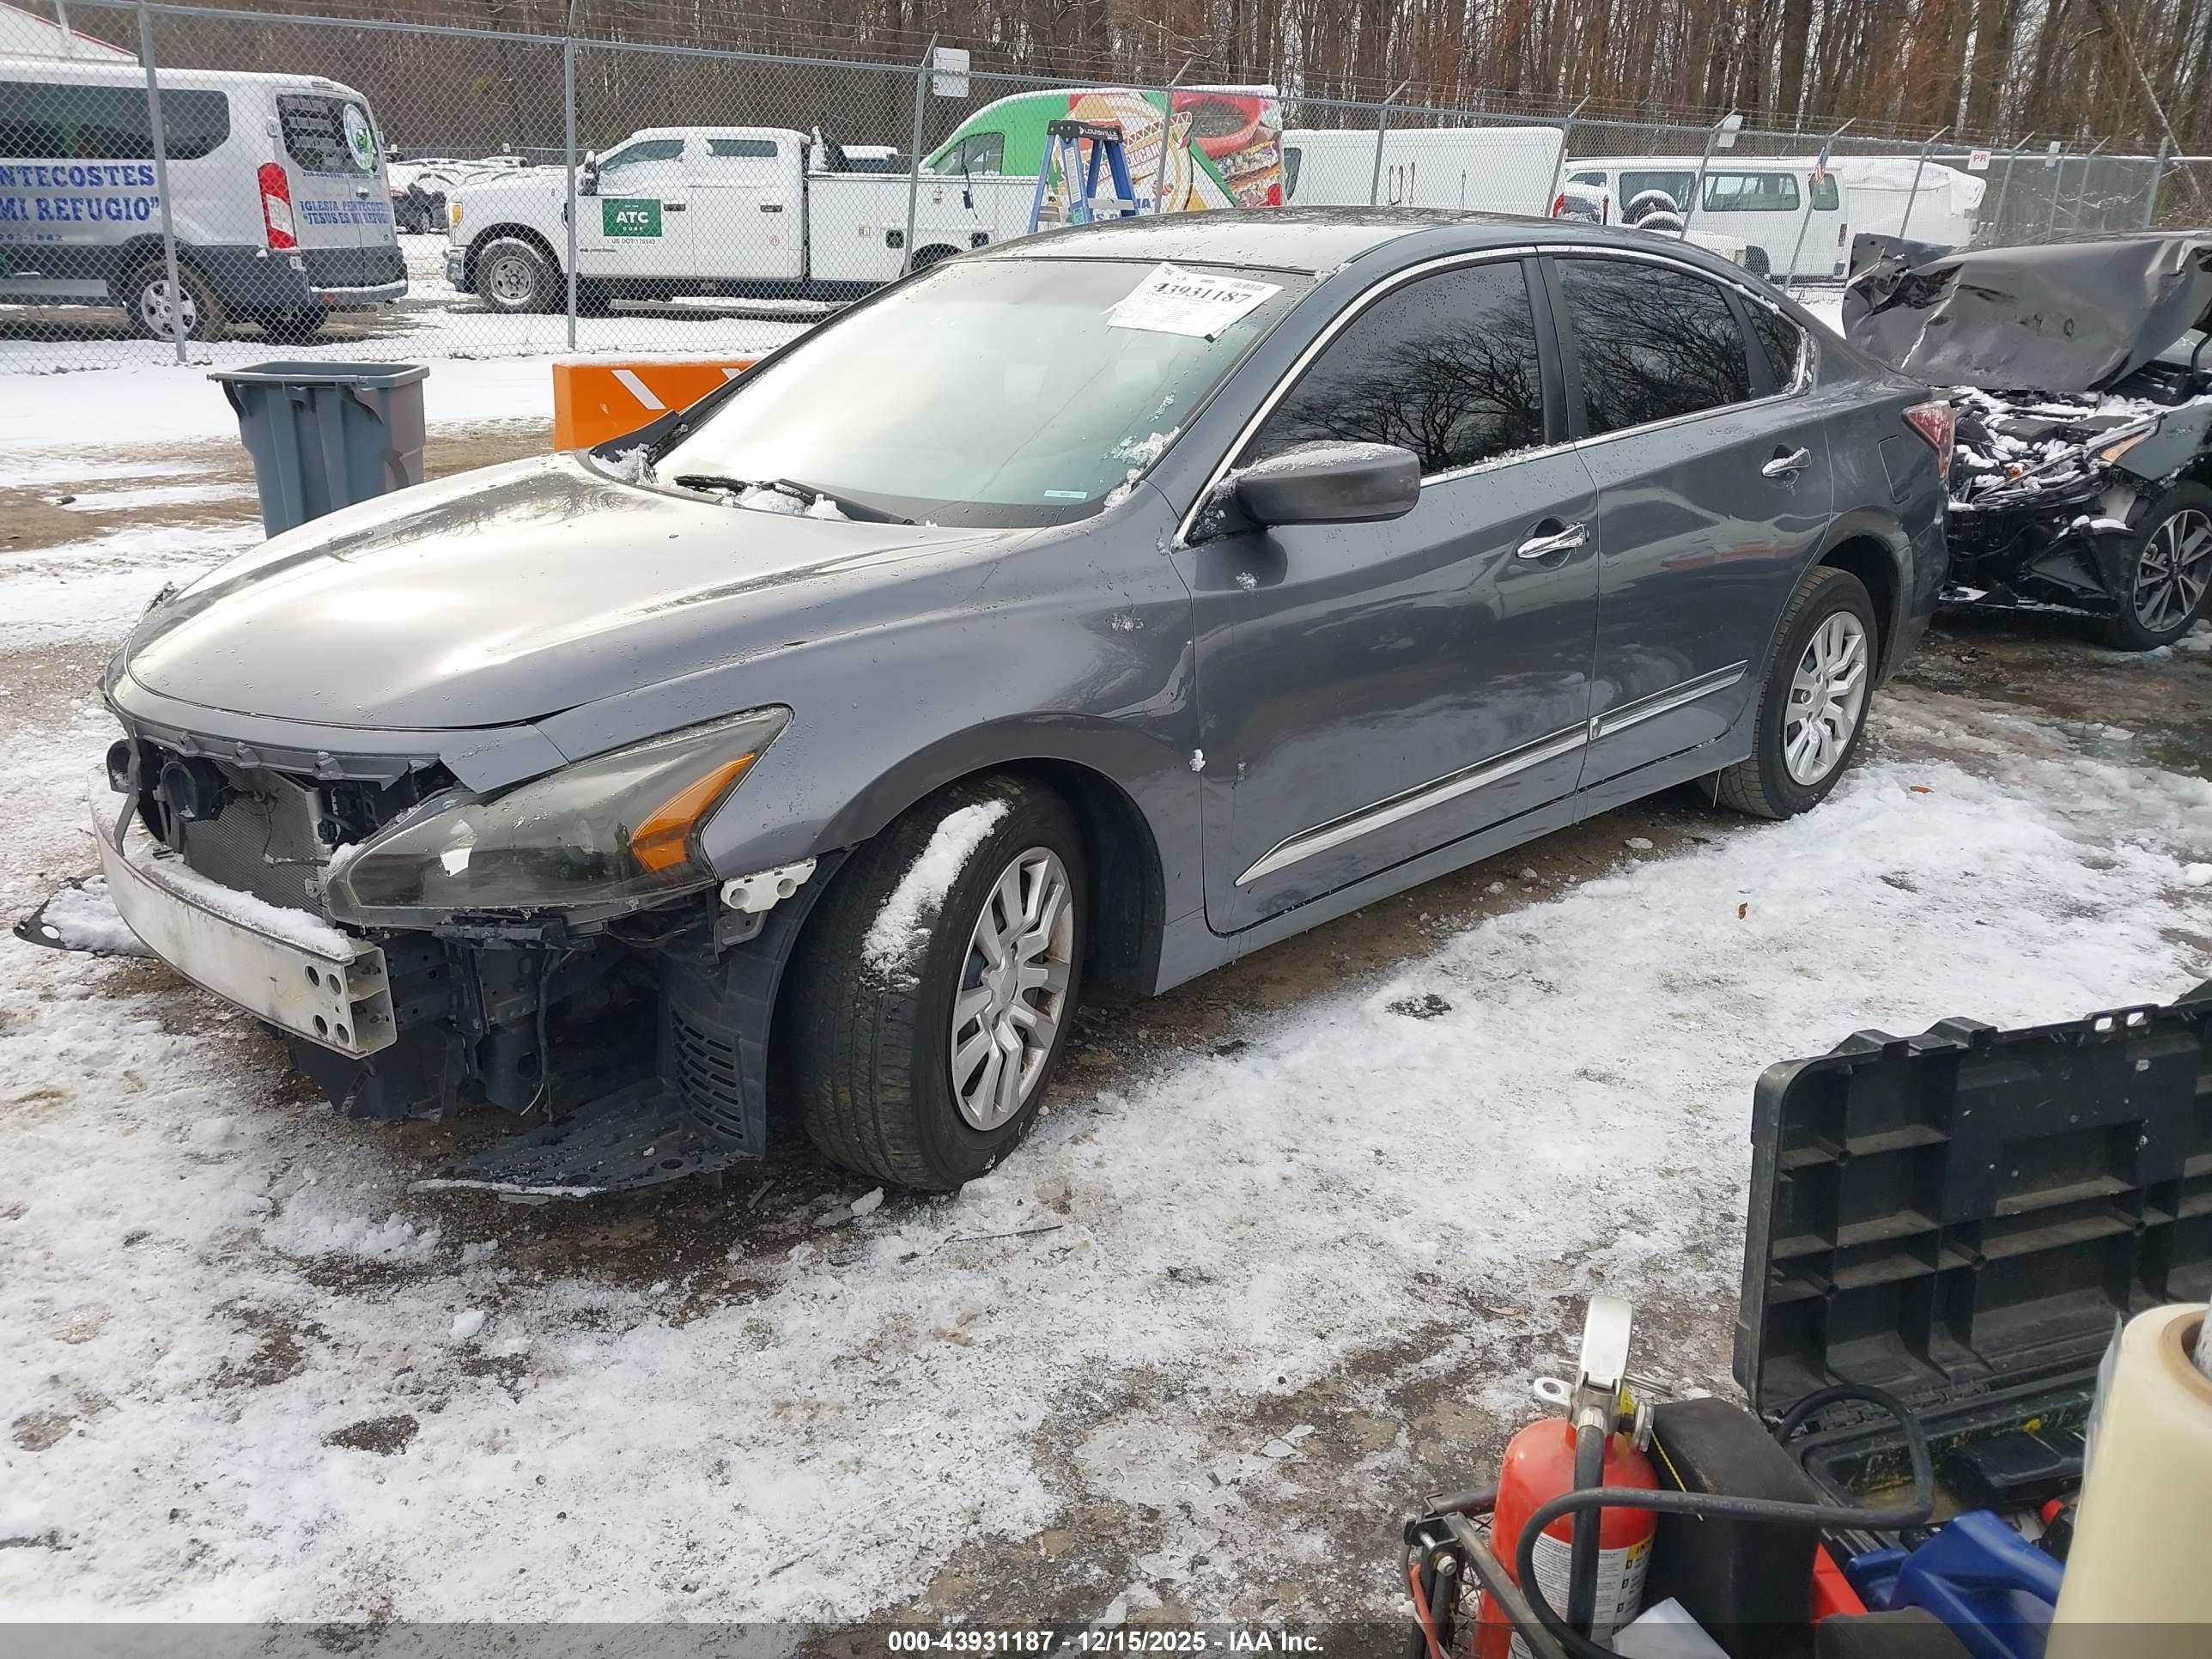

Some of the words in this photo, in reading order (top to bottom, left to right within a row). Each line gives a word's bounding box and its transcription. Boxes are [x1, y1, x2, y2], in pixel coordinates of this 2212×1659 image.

[300, 201, 340, 211] IGLESIA
[616, 211, 649, 223] ATC
[1154, 283, 1253, 304] 43931187
